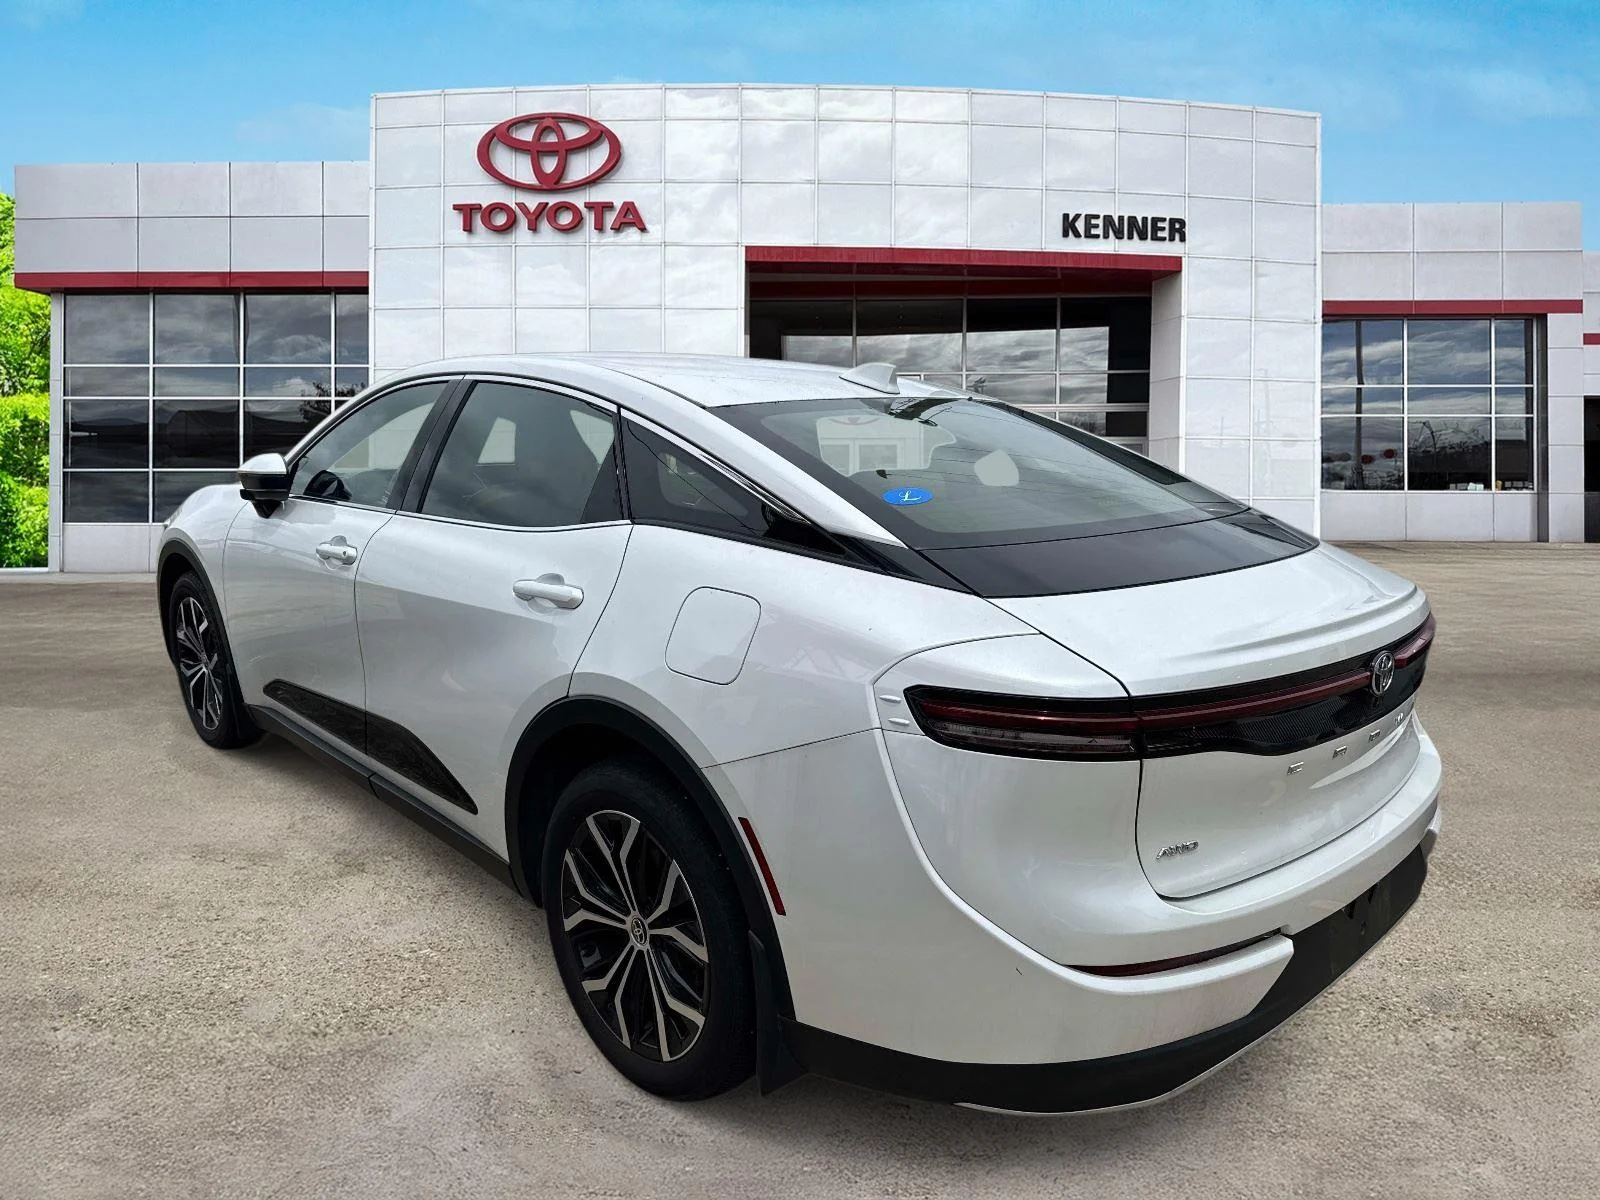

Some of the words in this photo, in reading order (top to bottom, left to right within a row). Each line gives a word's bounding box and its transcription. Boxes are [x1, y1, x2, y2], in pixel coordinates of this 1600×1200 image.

[452, 200, 647, 232] TOYOTA
[1062, 212, 1187, 243] KENNER
[1156, 840, 1199, 860] AWD
